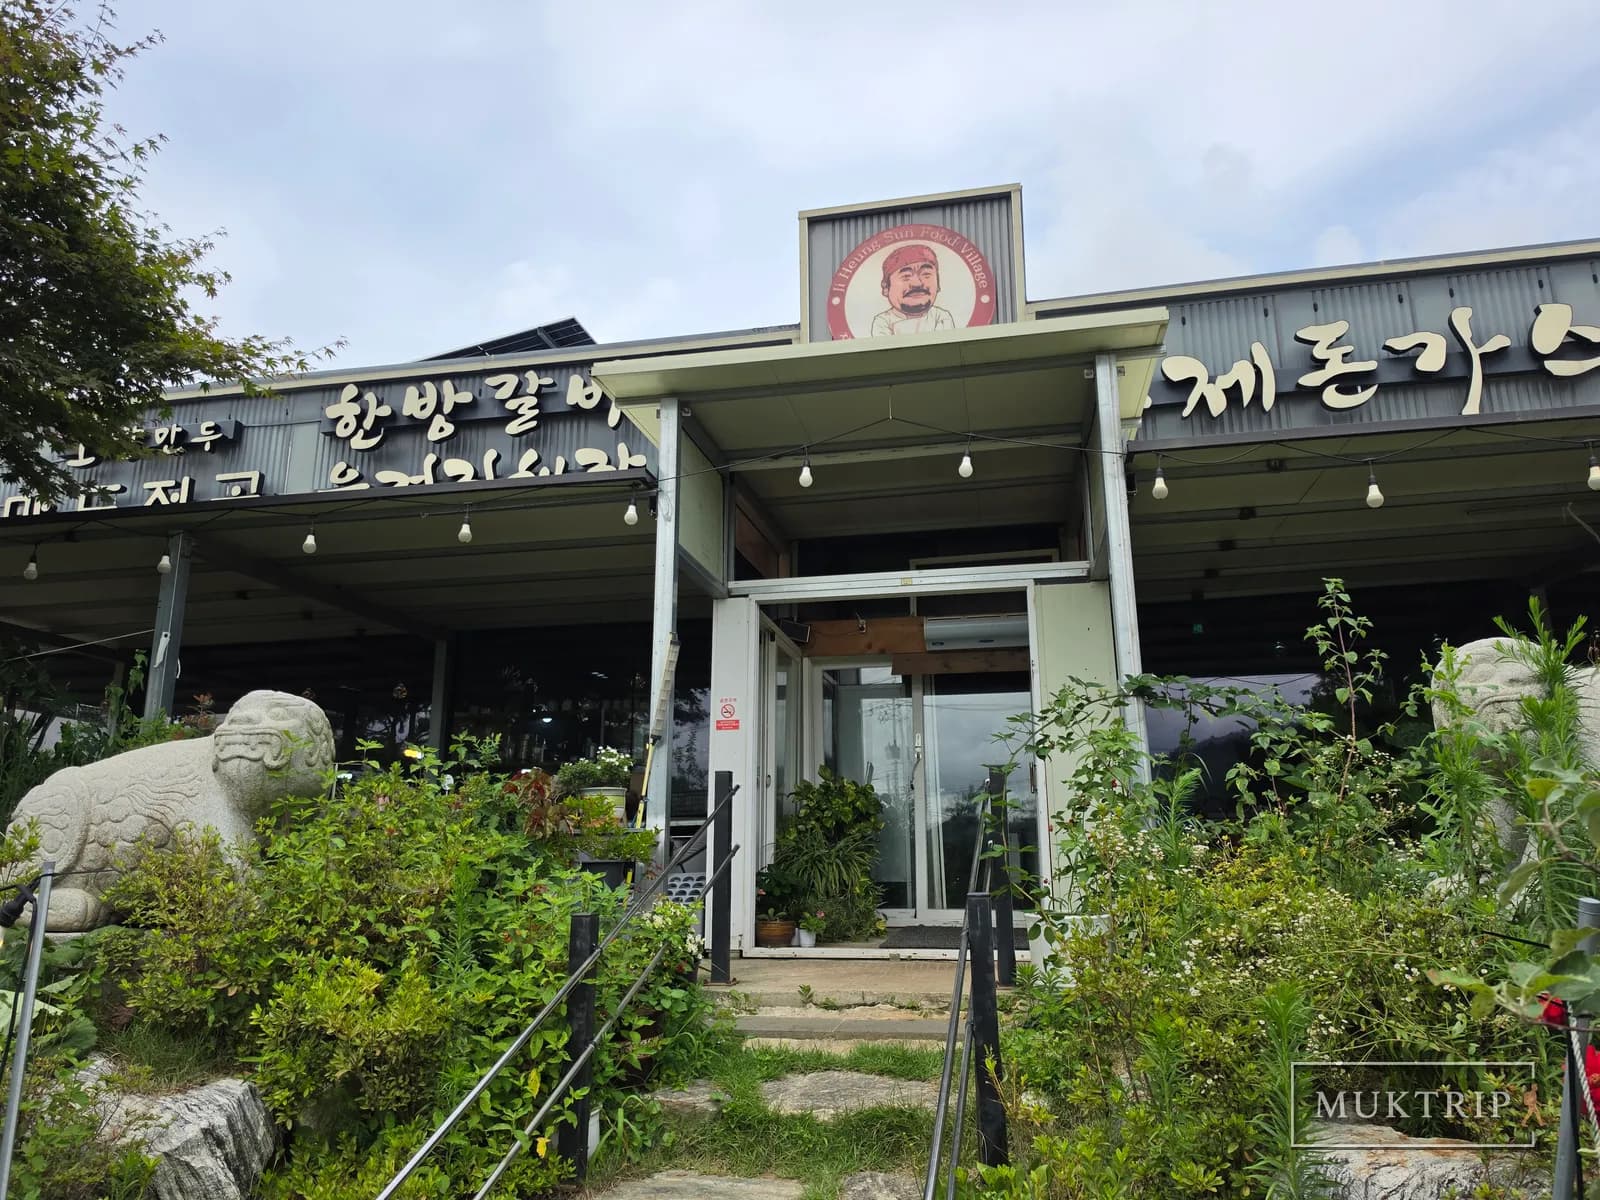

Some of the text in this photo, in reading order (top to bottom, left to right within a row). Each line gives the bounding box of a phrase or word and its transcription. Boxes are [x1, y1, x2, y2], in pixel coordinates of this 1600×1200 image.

[840, 240, 881, 280] Heung
[884, 229, 914, 243] Sun
[920, 227, 960, 249] Food
[960, 241, 989, 290] Village
[1143, 303, 1600, 417] 제돈가스
